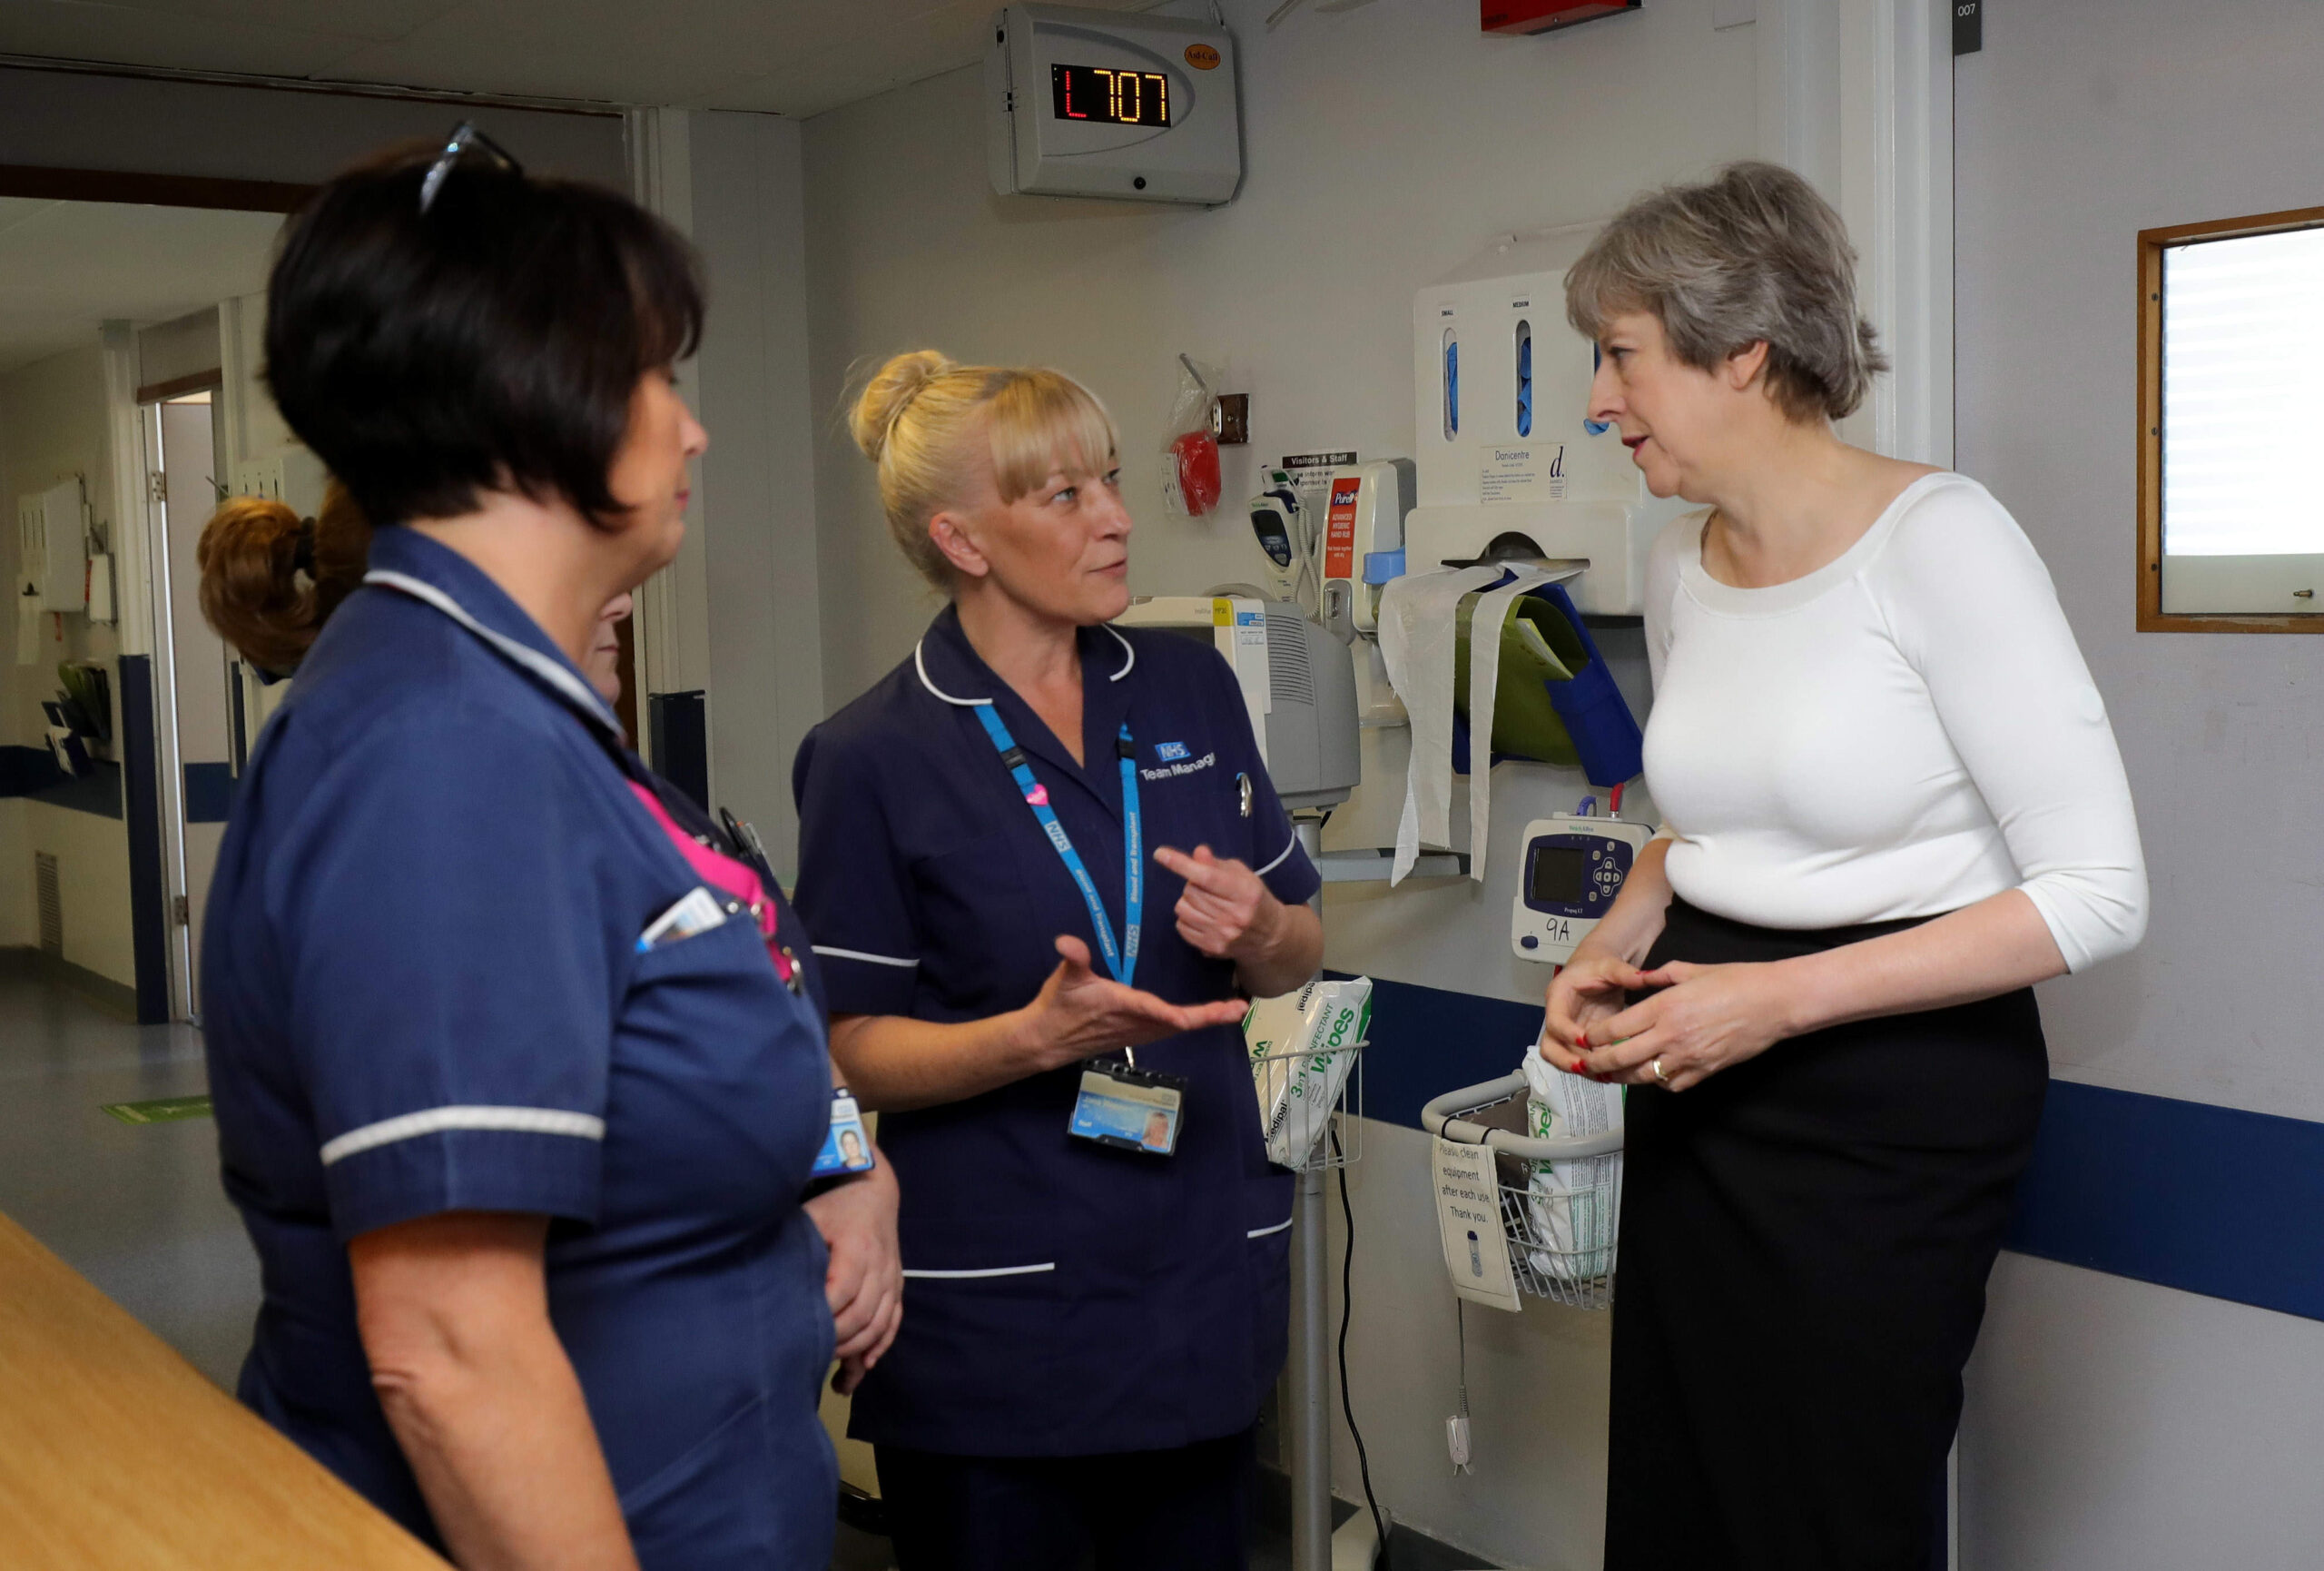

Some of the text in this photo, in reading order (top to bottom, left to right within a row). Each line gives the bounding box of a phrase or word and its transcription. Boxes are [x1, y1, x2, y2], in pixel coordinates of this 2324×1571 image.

[1957, 3, 1975, 16] 007
[1093, 69, 1166, 122] 707
[1291, 456, 1319, 465] Visitors
[1329, 454, 1348, 462] Staff
[1495, 450, 1530, 460] Danicentre
[1335, 492, 1354, 504] Purell
[1160, 744, 1186, 758] NHS
[1140, 768, 1172, 780] Team
[1047, 823, 1068, 850] NHS
[1129, 812, 1137, 855] Transplant
[1130, 857, 1138, 875] and
[1096, 913, 1114, 957] Transplant
[1546, 917, 1570, 941] 9A
[1460, 1147, 1479, 1160] clean
[1443, 1166, 1480, 1181] equipment
[1442, 1184, 1458, 1197] after
[1460, 1189, 1476, 1200] each
[1450, 1205, 1472, 1220] Thank
